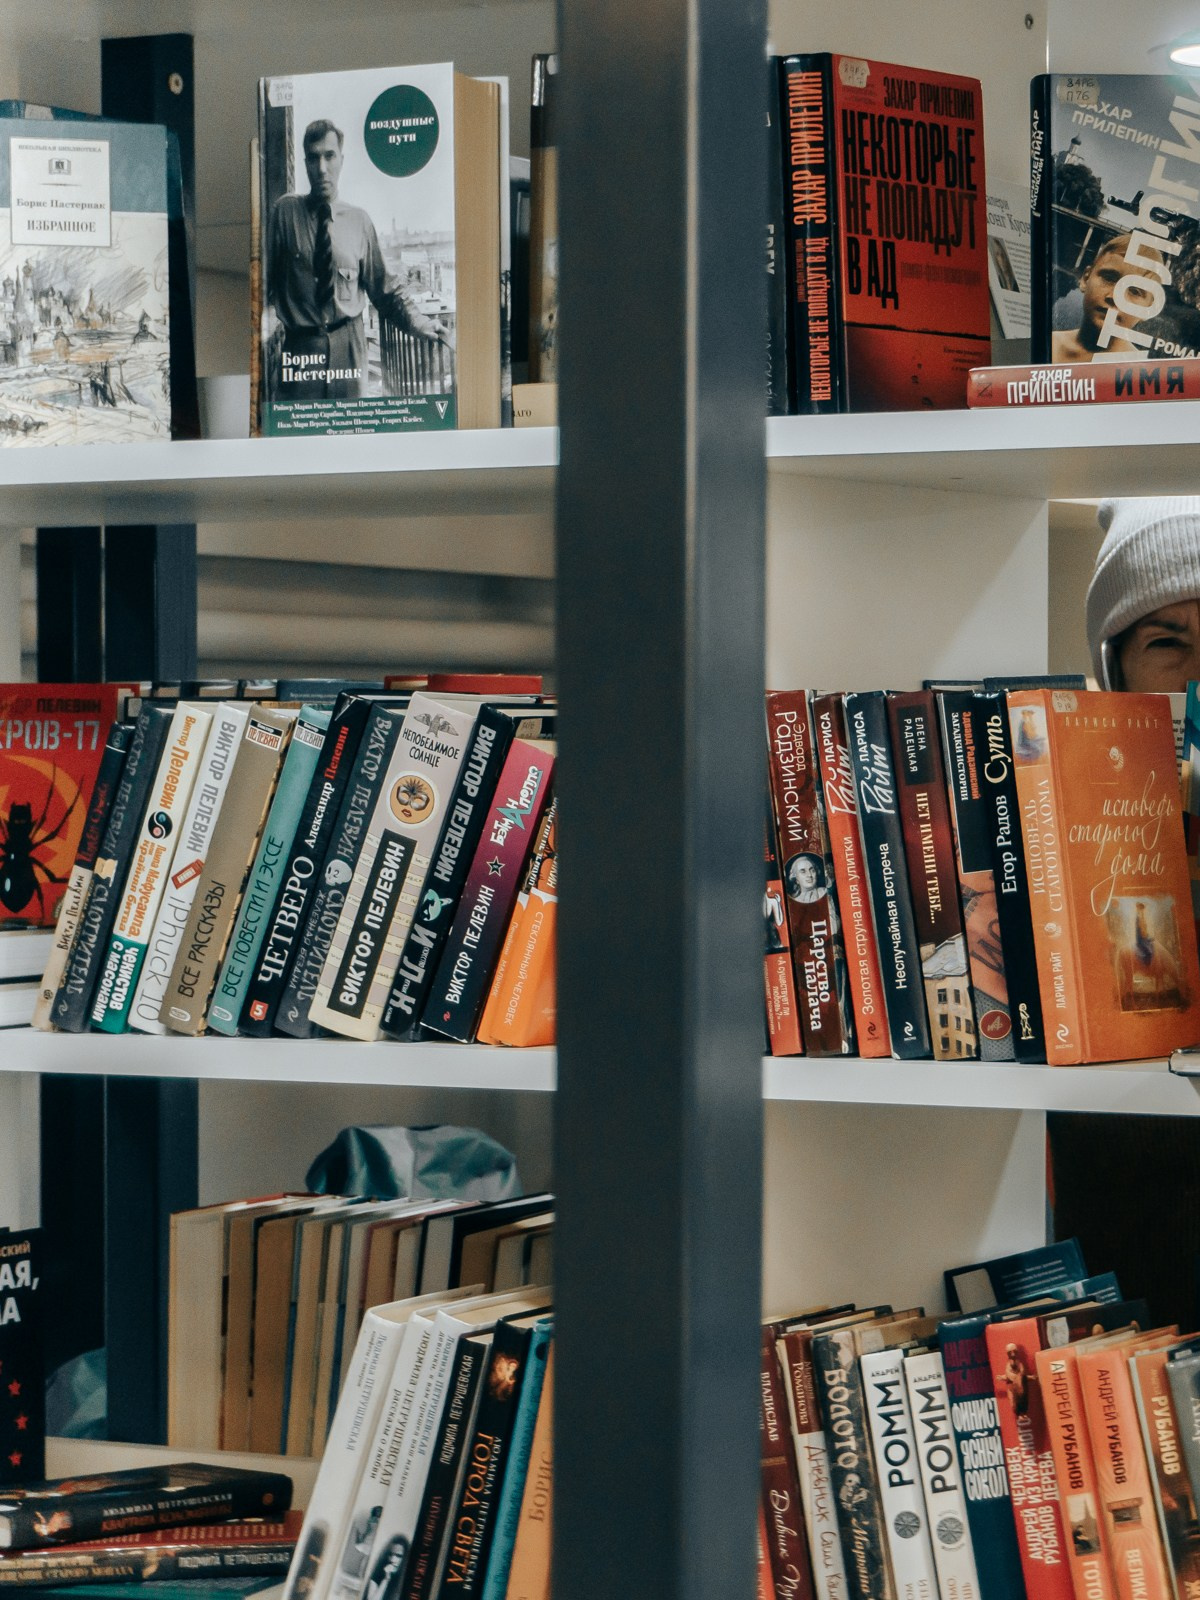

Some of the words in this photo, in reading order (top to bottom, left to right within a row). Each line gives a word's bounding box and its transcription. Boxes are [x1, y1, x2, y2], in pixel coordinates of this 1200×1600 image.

[370, 114, 435, 132] воздушные
[788, 71, 825, 165] ПРИЛЕПИН
[883, 76, 917, 108] ЗАХАР
[920, 81, 975, 121] ПРИЛЕПИН
[388, 131, 416, 145] пути
[841, 108, 977, 191] НЕКОТОРЫЕ
[1072, 110, 1161, 151] ПРИЛЕПИН
[17, 199, 47, 208] Борис
[51, 200, 105, 210] Пастернак
[792, 165, 828, 226] ЗАХАР
[844, 175, 872, 235] НЕ
[876, 180, 978, 257] ПОПАДУТ
[27, 220, 96, 233] ИЗБРАННОЕ
[805, 236, 830, 250] АД
[806, 254, 827, 263] В
[847, 236, 862, 296] В
[868, 239, 899, 310] АД
[806, 267, 831, 317] ПОПАДУТ
[808, 319, 829, 333] НЕ
[282, 352, 326, 369] Борис
[282, 368, 362, 383] Пастернак
[809, 335, 831, 401] НЕКОТОРЫЕ
[1030, 368, 1072, 380] ЗАХАР
[1115, 364, 1185, 397] ИМЯ
[1007, 378, 1096, 404] ПРИЛЕПИН
[177, 714, 197, 747] Виктор
[206, 720, 237, 782] ВИКТОР
[402, 727, 460, 760] НЕПОБЕДИМОЕ
[824, 711, 836, 762] ЛАРИСА
[854, 710, 870, 762] ЛАРИСА
[903, 718, 919, 774] РАДЕЦКАЯ
[914, 717, 927, 752] ЕЛЕНА
[983, 715, 1012, 785] Суть
[159, 745, 190, 811] Пелевин
[409, 746, 441, 769] СОЛНЦЕ
[462, 724, 497, 796] ВИКТОР
[187, 784, 220, 854] ПЕЛЕВИН
[916, 792, 930, 820] НЕТ
[995, 795, 1015, 847] Радов
[1038, 778, 1060, 825] ДОМА
[257, 855, 315, 986] ЧЕТВЕРО
[304, 781, 336, 850] Александр
[324, 725, 349, 780] Пелевин
[433, 796, 474, 882] ПЕЛЕВИН
[843, 835, 861, 881] улитки
[919, 823, 937, 874] ИМЕНИ
[1024, 797, 1048, 895] ИСПОВЕДЬ
[1068, 820, 1147, 864] старого
[877, 842, 897, 899] встреча
[1000, 849, 1018, 894] Егор
[1040, 825, 1065, 912] СТАРОГО
[851, 882, 862, 909] для
[147, 895, 193, 987] iPhuck
[188, 879, 228, 968] РАССКАЗЫ
[339, 930, 376, 1007] ВИКТОР
[364, 840, 406, 931] ПЕЛЕВИН
[445, 951, 475, 1005] ВИКТОР
[462, 885, 496, 950] ПЕЛЕВИН
[855, 910, 872, 957] струна
[884, 900, 908, 989] Неслучайная
[178, 966, 201, 998] ВСЕ
[808, 919, 833, 1004] Царство
[860, 955, 874, 1015] Золотая
[1050, 951, 1063, 972] РАЙТ
[135, 986, 159, 1023] 10
[1054, 974, 1066, 1008] ЛАРИСА
[382, 1388, 402, 1436] рассказы
[824, 1369, 859, 1469] БОЛОТО
[871, 1378, 915, 1489] РОММ
[1051, 1360, 1074, 1421] АНДРЕЙ
[1064, 1422, 1085, 1491] РУБАНОВ
[1097, 1368, 1115, 1423] АНДРЕЙ
[1106, 1424, 1127, 1486] РУБАНОВ
[1151, 1394, 1181, 1478] РУБАНОВ
[370, 1448, 386, 1480] любви
[914, 1384, 958, 1495] РОММ
[1017, 1416, 1041, 1484] КРАСНОГО
[462, 1431, 495, 1508] ГОРОД
[1005, 1446, 1021, 1506] ЧЕЛОВЕК
[1039, 1450, 1058, 1502] ДЕРЕВА
[1025, 1486, 1041, 1507] ИЗ
[446, 1518, 478, 1584] СВЕТА
[1021, 1507, 1043, 1561] АНДРЕЙ
[1037, 1504, 1062, 1565] РУБАНОВ
